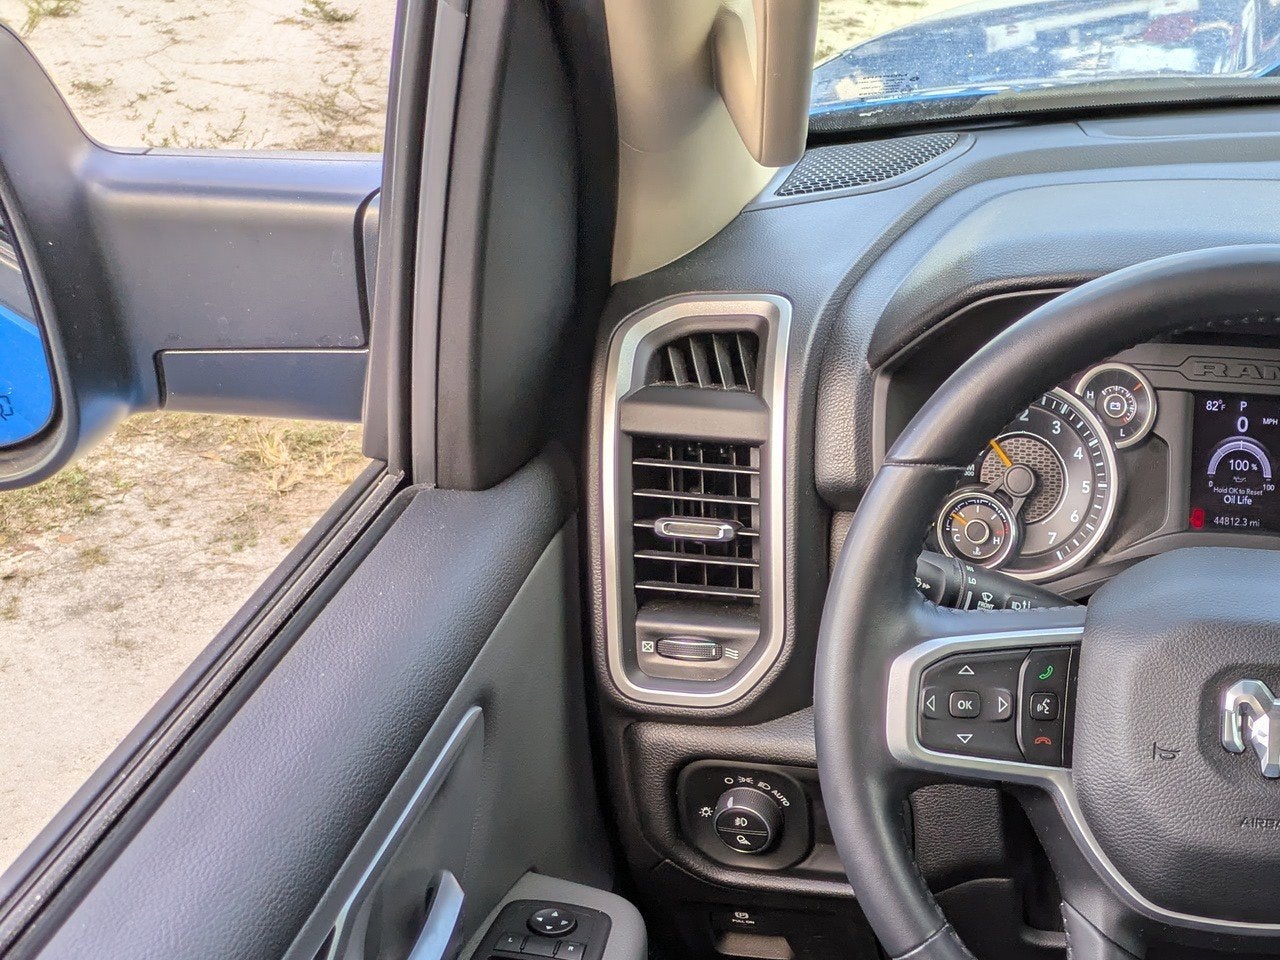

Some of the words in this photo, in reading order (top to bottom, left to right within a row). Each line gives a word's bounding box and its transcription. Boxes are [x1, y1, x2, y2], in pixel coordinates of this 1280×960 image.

[1086, 390, 1095, 399] H
[1240, 401, 1248, 412] P
[1237, 416, 1249, 433] 0
[1262, 417, 1279, 426] MPH
[1052, 421, 1062, 434] 3
[1120, 429, 1126, 437] L
[1073, 447, 1083, 460] 4
[1229, 460, 1250, 471] 100
[1081, 481, 1091, 494] 5
[1223, 494, 1236, 504] Oil
[1237, 495, 1253, 505] Life
[1070, 510, 1079, 522] 6
[1213, 516, 1248, 526] 44812.3
[953, 533, 961, 542] C
[993, 537, 1001, 545] H
[1048, 532, 1057, 545] 7
[957, 699, 973, 711] OK
[771, 789, 791, 807] AUTO
